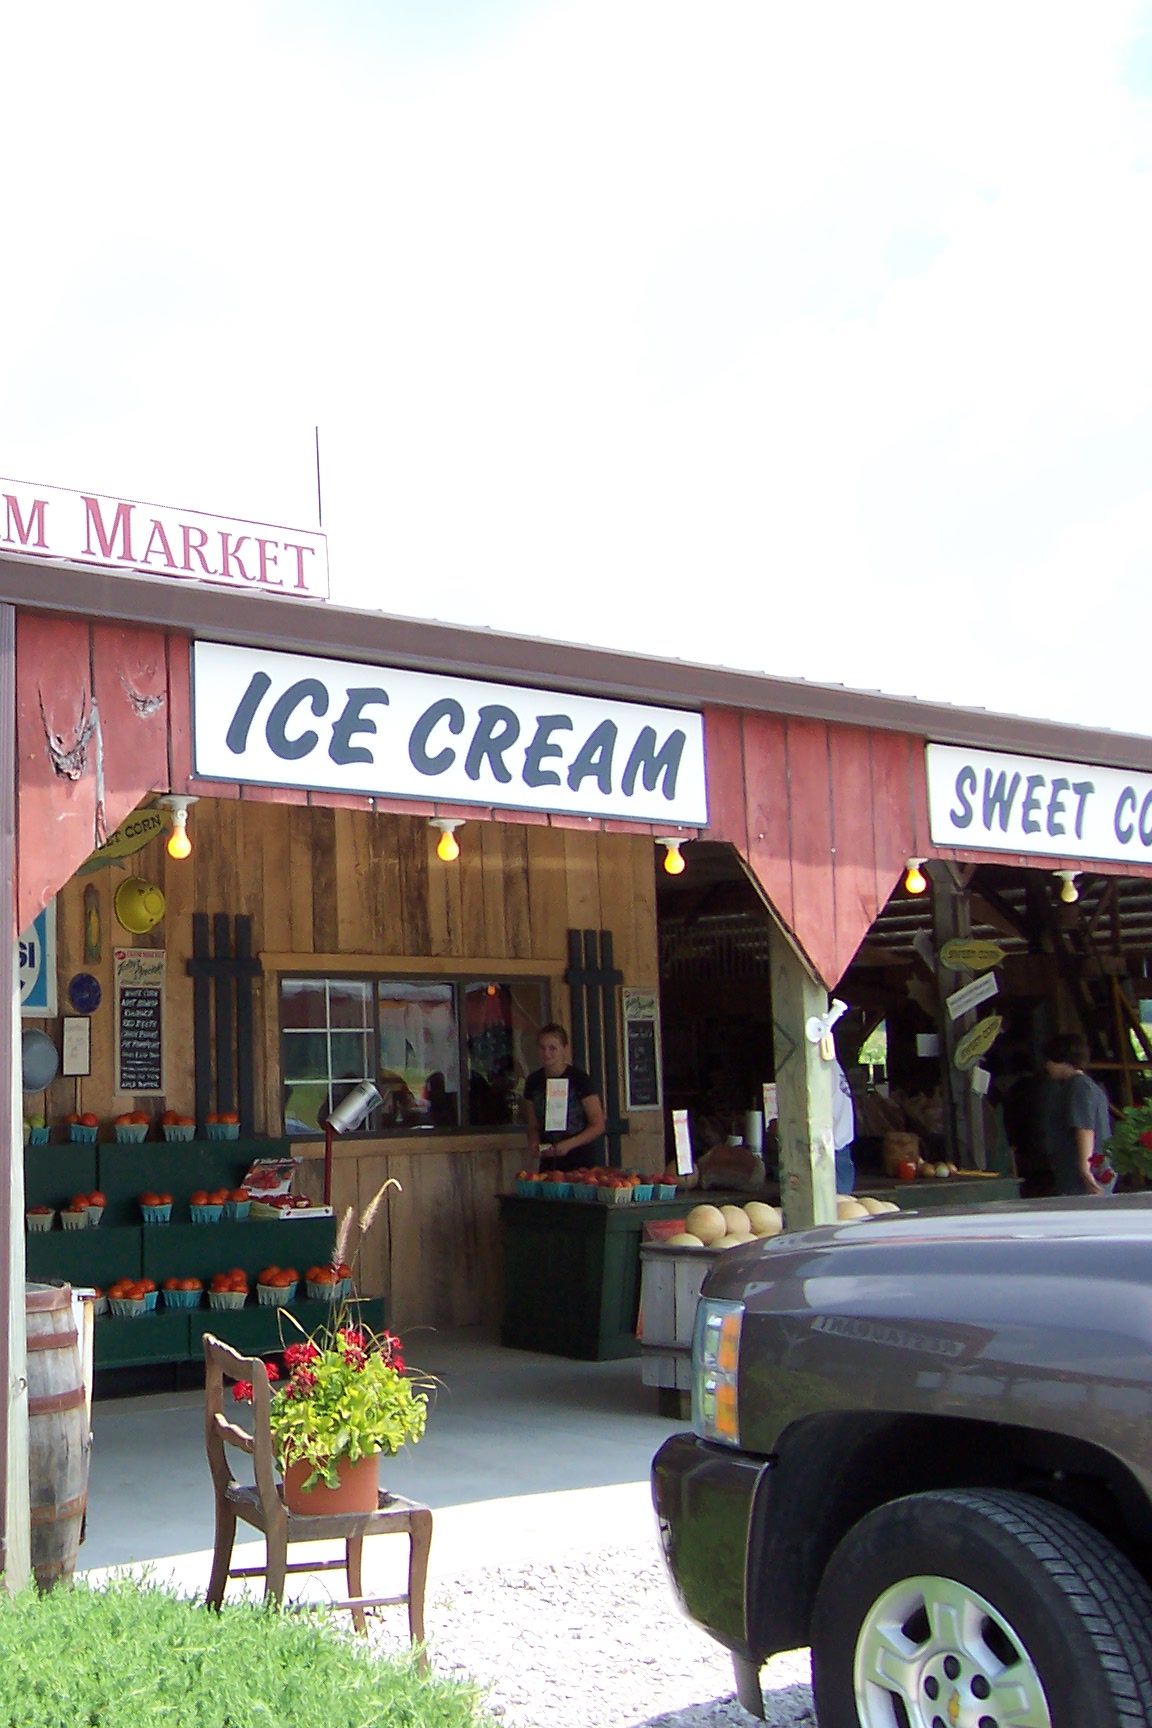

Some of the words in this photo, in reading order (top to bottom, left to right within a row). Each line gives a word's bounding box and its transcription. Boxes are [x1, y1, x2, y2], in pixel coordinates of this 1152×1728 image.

[80, 495, 315, 590] MARKET
[225, 671, 390, 766] ICE
[408, 698, 686, 801] CREAM
[125, 814, 161, 838] CORN
[949, 765, 1095, 840] SWEET
[1113, 785, 1152, 847] CO
